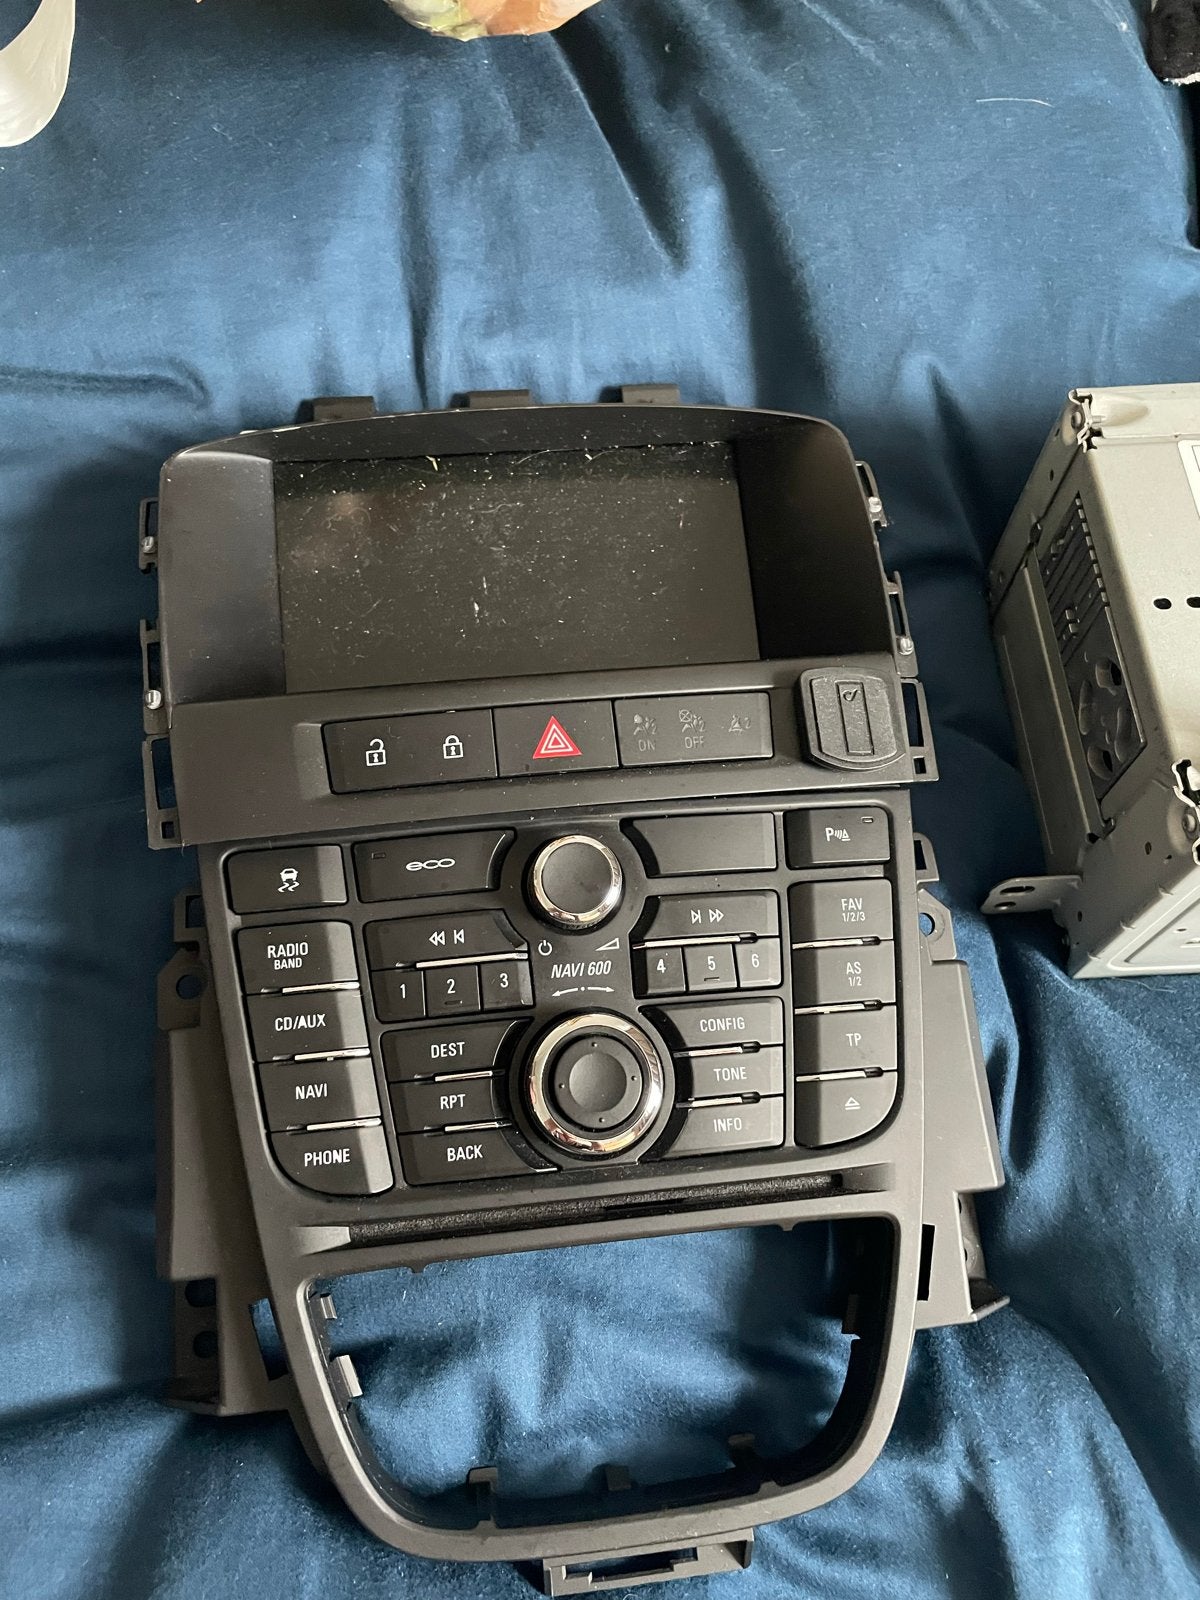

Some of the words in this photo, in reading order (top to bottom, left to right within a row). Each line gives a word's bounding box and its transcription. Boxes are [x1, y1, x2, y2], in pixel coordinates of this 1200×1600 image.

[638, 739, 655, 752] ON
[685, 736, 705, 749] OFF
[841, 897, 863, 911] FAV
[841, 911, 866, 922] 1/2/3
[267, 941, 309, 959] RADIO
[273, 957, 303, 970] BAND
[656, 959, 666, 973] 4
[707, 956, 716, 971] 5
[751, 953, 760, 968] 6
[551, 962, 584, 979] NAVI
[587, 960, 612, 976] 600
[846, 962, 862, 975] AS
[446, 979, 456, 994] 2
[499, 973, 509, 988] 3
[847, 976, 862, 987] 1/2
[400, 983, 406, 998] 1
[274, 1013, 326, 1032] CD/AUX
[699, 1016, 746, 1032] CONFIG
[846, 1033, 862, 1047] TP
[430, 1041, 465, 1058] DEST
[713, 1066, 747, 1081] TONE
[295, 1082, 328, 1099] NAVI
[440, 1093, 466, 1109] RPT
[713, 1118, 742, 1132] INFO
[304, 1147, 351, 1166] PHONE
[447, 1144, 483, 1161] BACK
